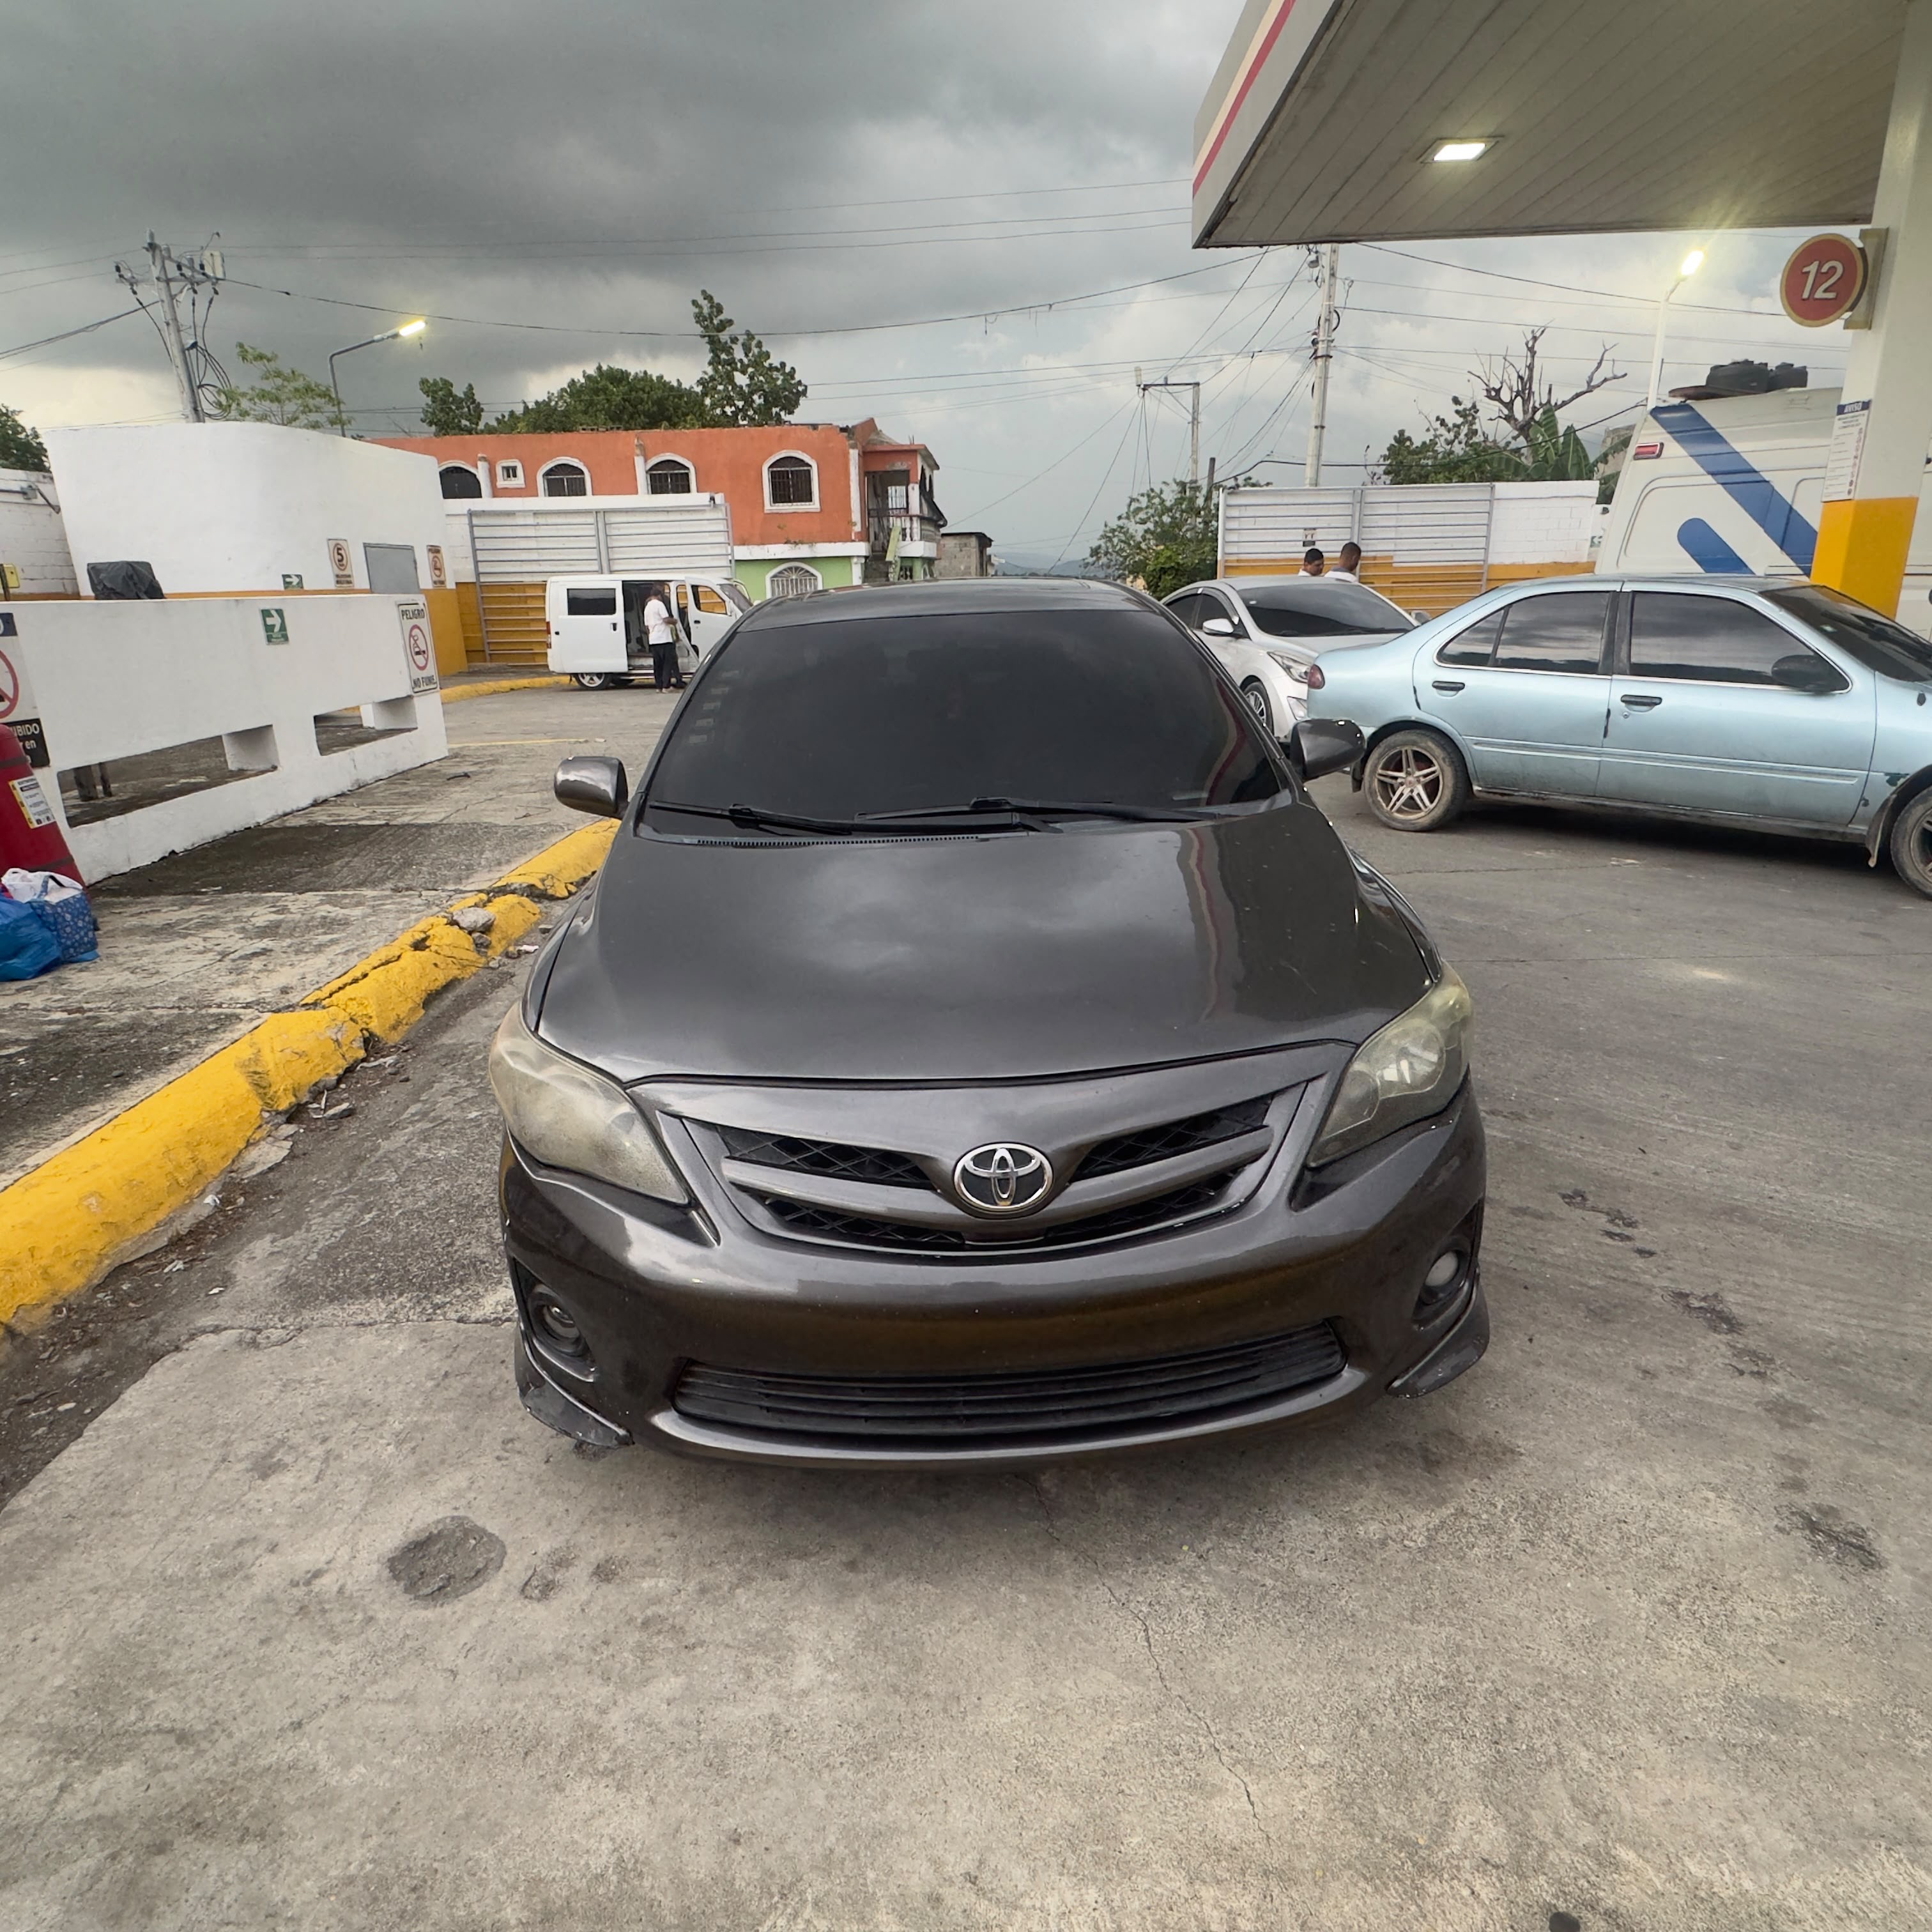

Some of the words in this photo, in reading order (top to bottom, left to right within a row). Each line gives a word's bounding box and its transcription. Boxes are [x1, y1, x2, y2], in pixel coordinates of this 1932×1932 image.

[1802, 260, 1843, 300] 12
[336, 547, 344, 562] 5
[401, 608, 425, 620] PELIGRO
[413, 677, 421, 688] NO
[25, 740, 36, 749] en
